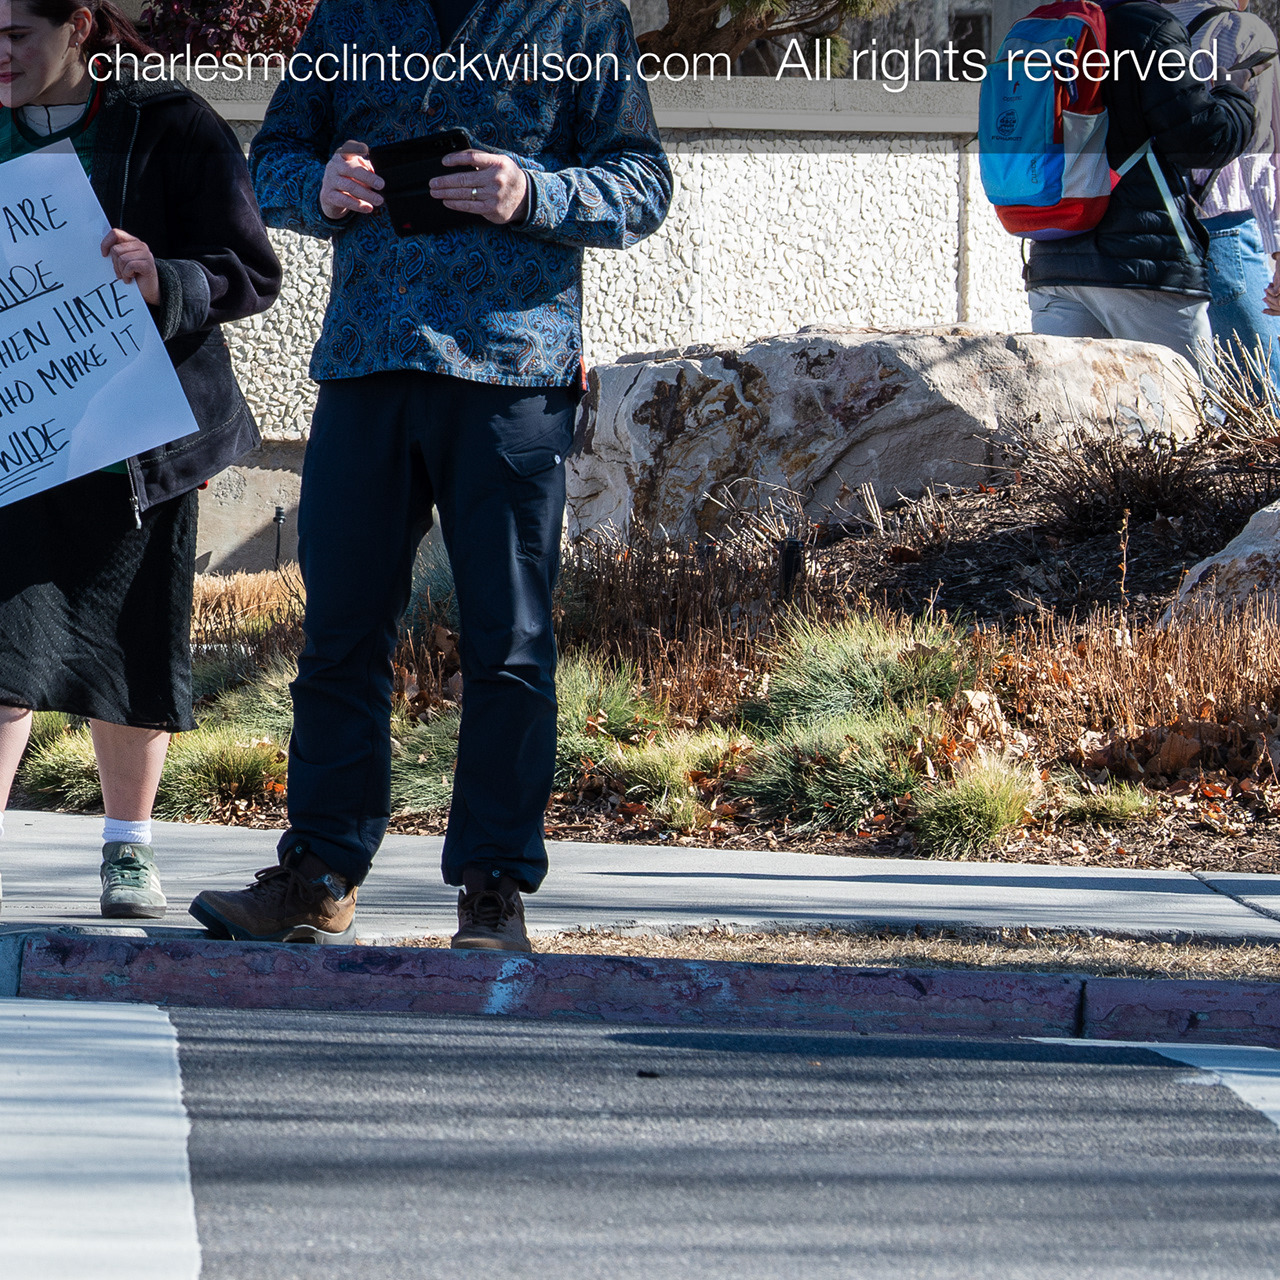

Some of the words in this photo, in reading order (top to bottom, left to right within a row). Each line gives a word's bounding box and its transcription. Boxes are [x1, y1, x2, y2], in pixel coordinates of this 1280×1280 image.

[3, 194, 68, 243] ARE
[58, 278, 135, 346] HATE
[38, 342, 108, 397] MAKE
[115, 323, 142, 358] IT
